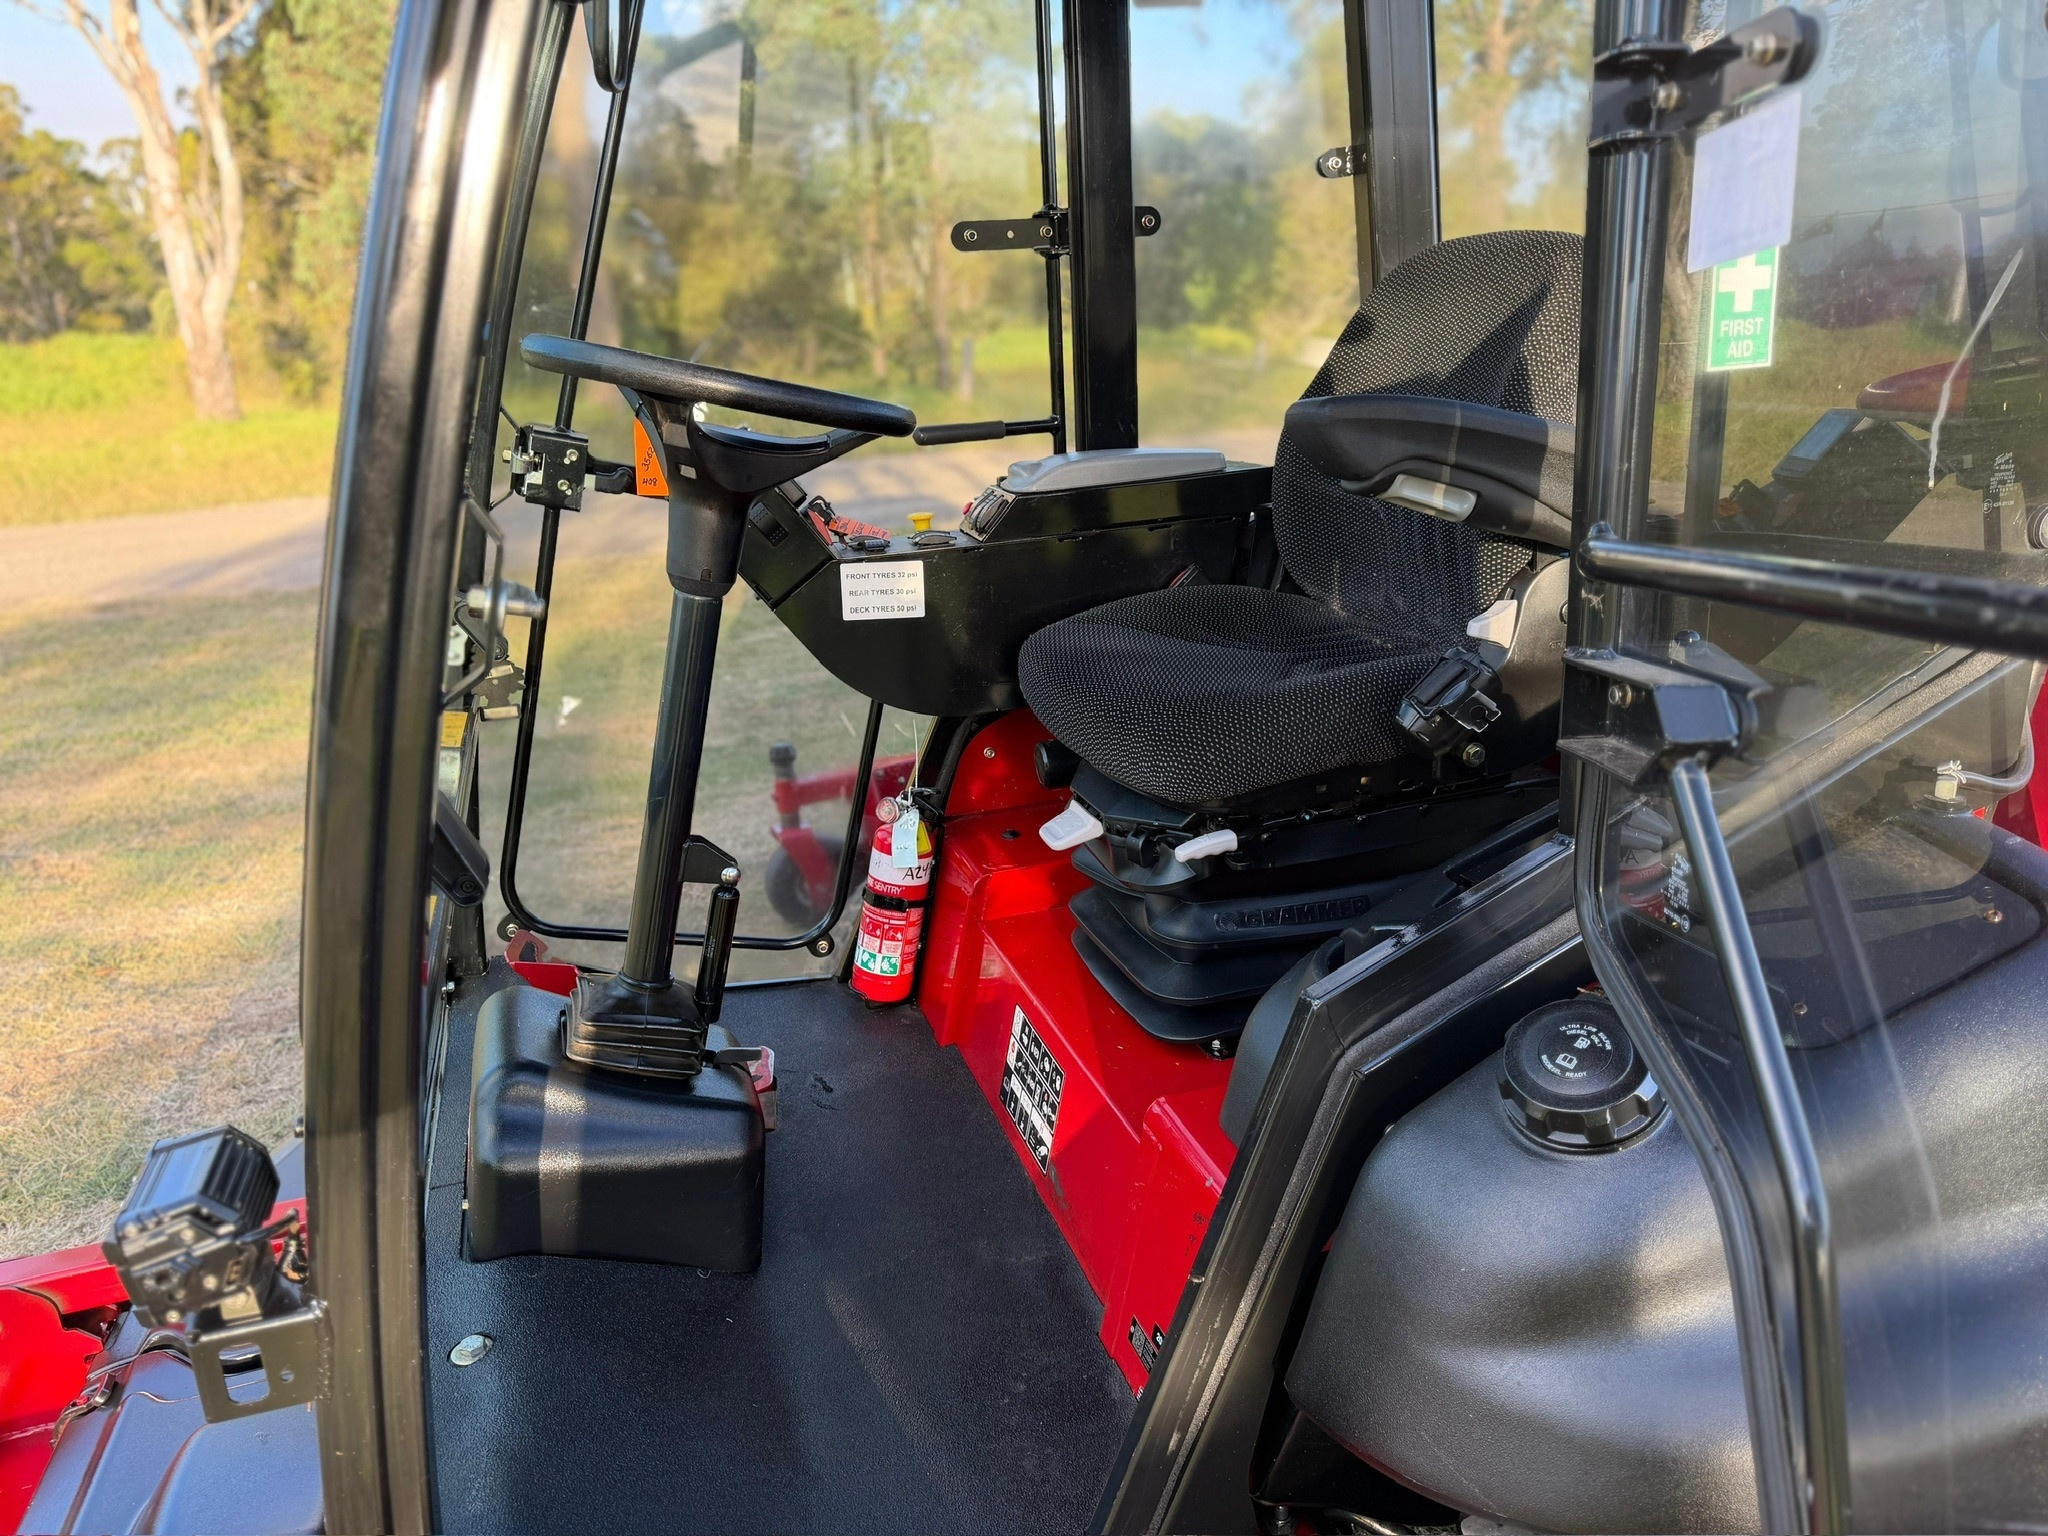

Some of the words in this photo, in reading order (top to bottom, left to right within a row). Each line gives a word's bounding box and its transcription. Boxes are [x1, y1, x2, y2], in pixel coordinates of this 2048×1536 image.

[1720, 317, 1764, 337] FIRST
[1727, 339, 1754, 358] AID
[642, 477, 658, 486] 408
[907, 571, 918, 579] psi
[849, 606, 870, 614] DECK
[871, 605, 896, 613] TYRES
[906, 604, 917, 612] psi
[874, 881, 902, 895] SENTRY
[1583, 1024, 1598, 1032] LOW
[1598, 1032, 1612, 1050] SULFUR
[1591, 1034, 1603, 1047] ONLY
